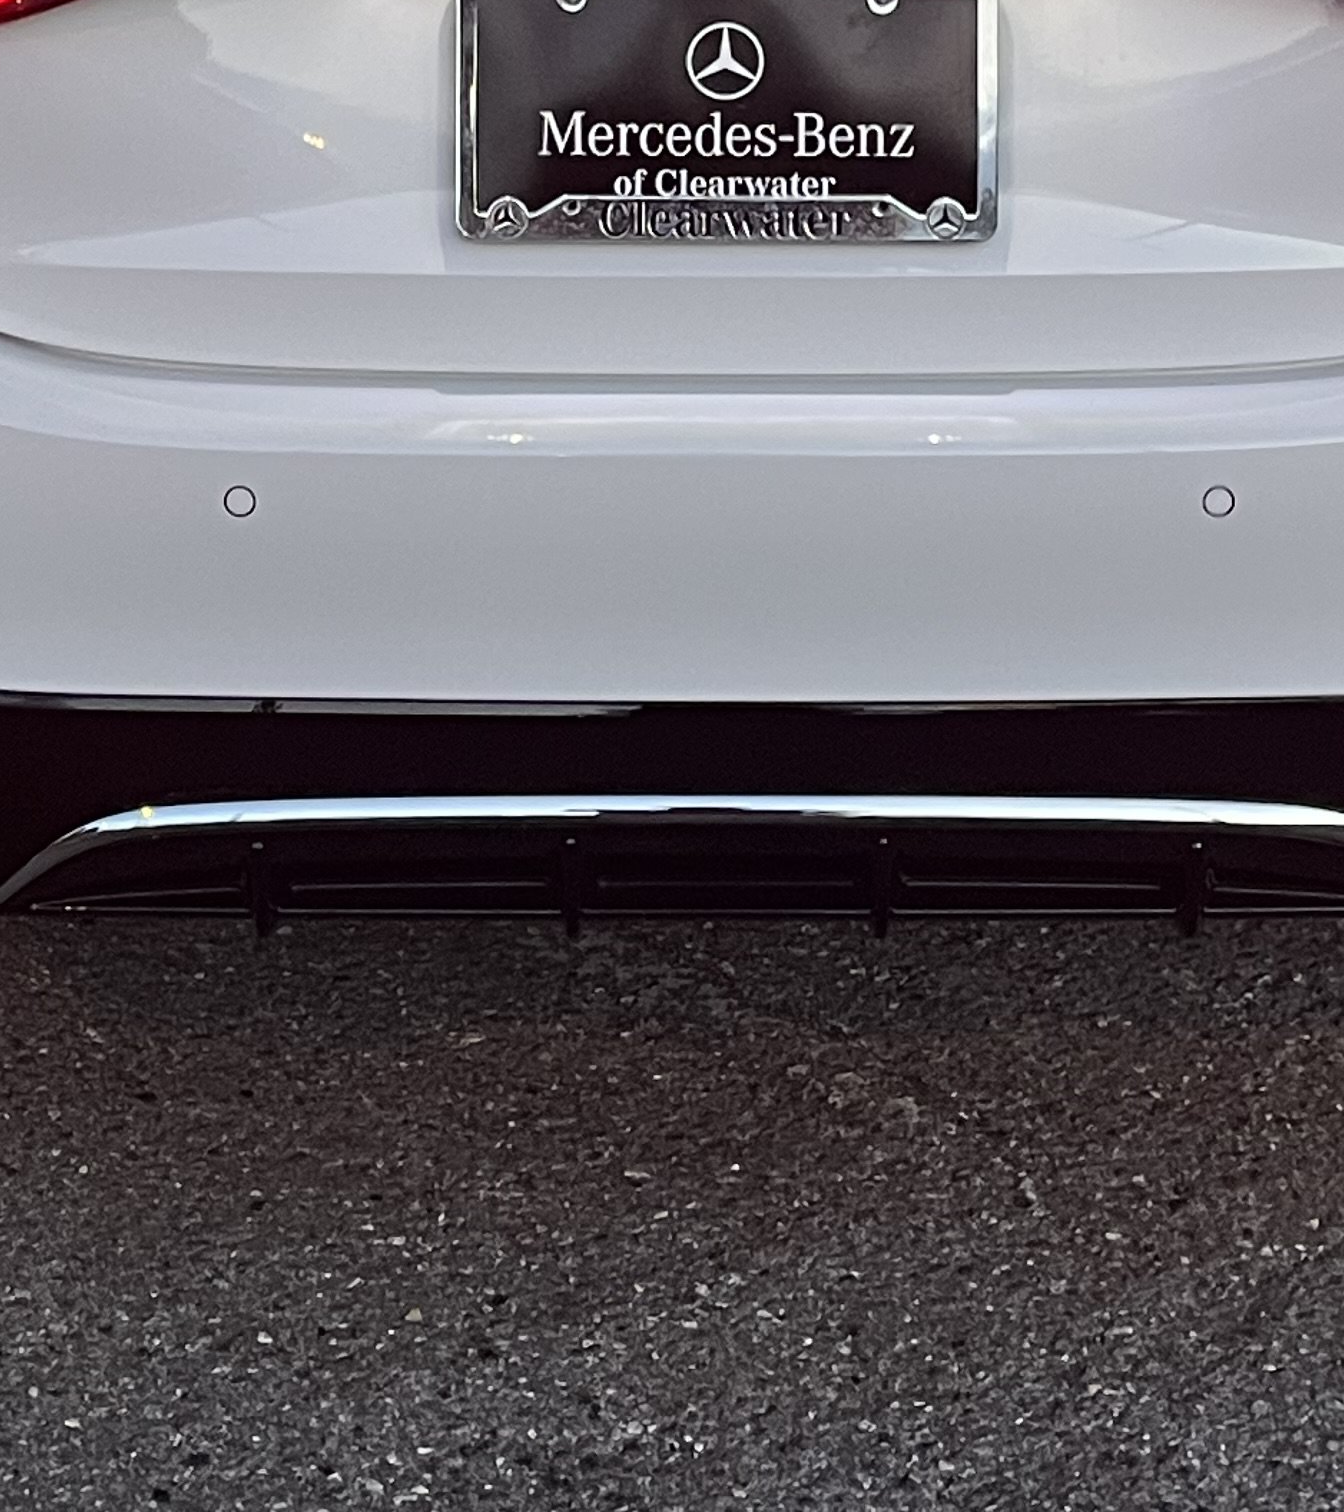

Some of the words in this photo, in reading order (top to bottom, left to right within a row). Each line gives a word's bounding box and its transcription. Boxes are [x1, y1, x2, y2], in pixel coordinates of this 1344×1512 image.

[538, 110, 915, 158] Mercedes-Benz
[613, 168, 646, 197] of
[655, 168, 837, 197] Clearwater
[598, 200, 851, 241] Clearwater
